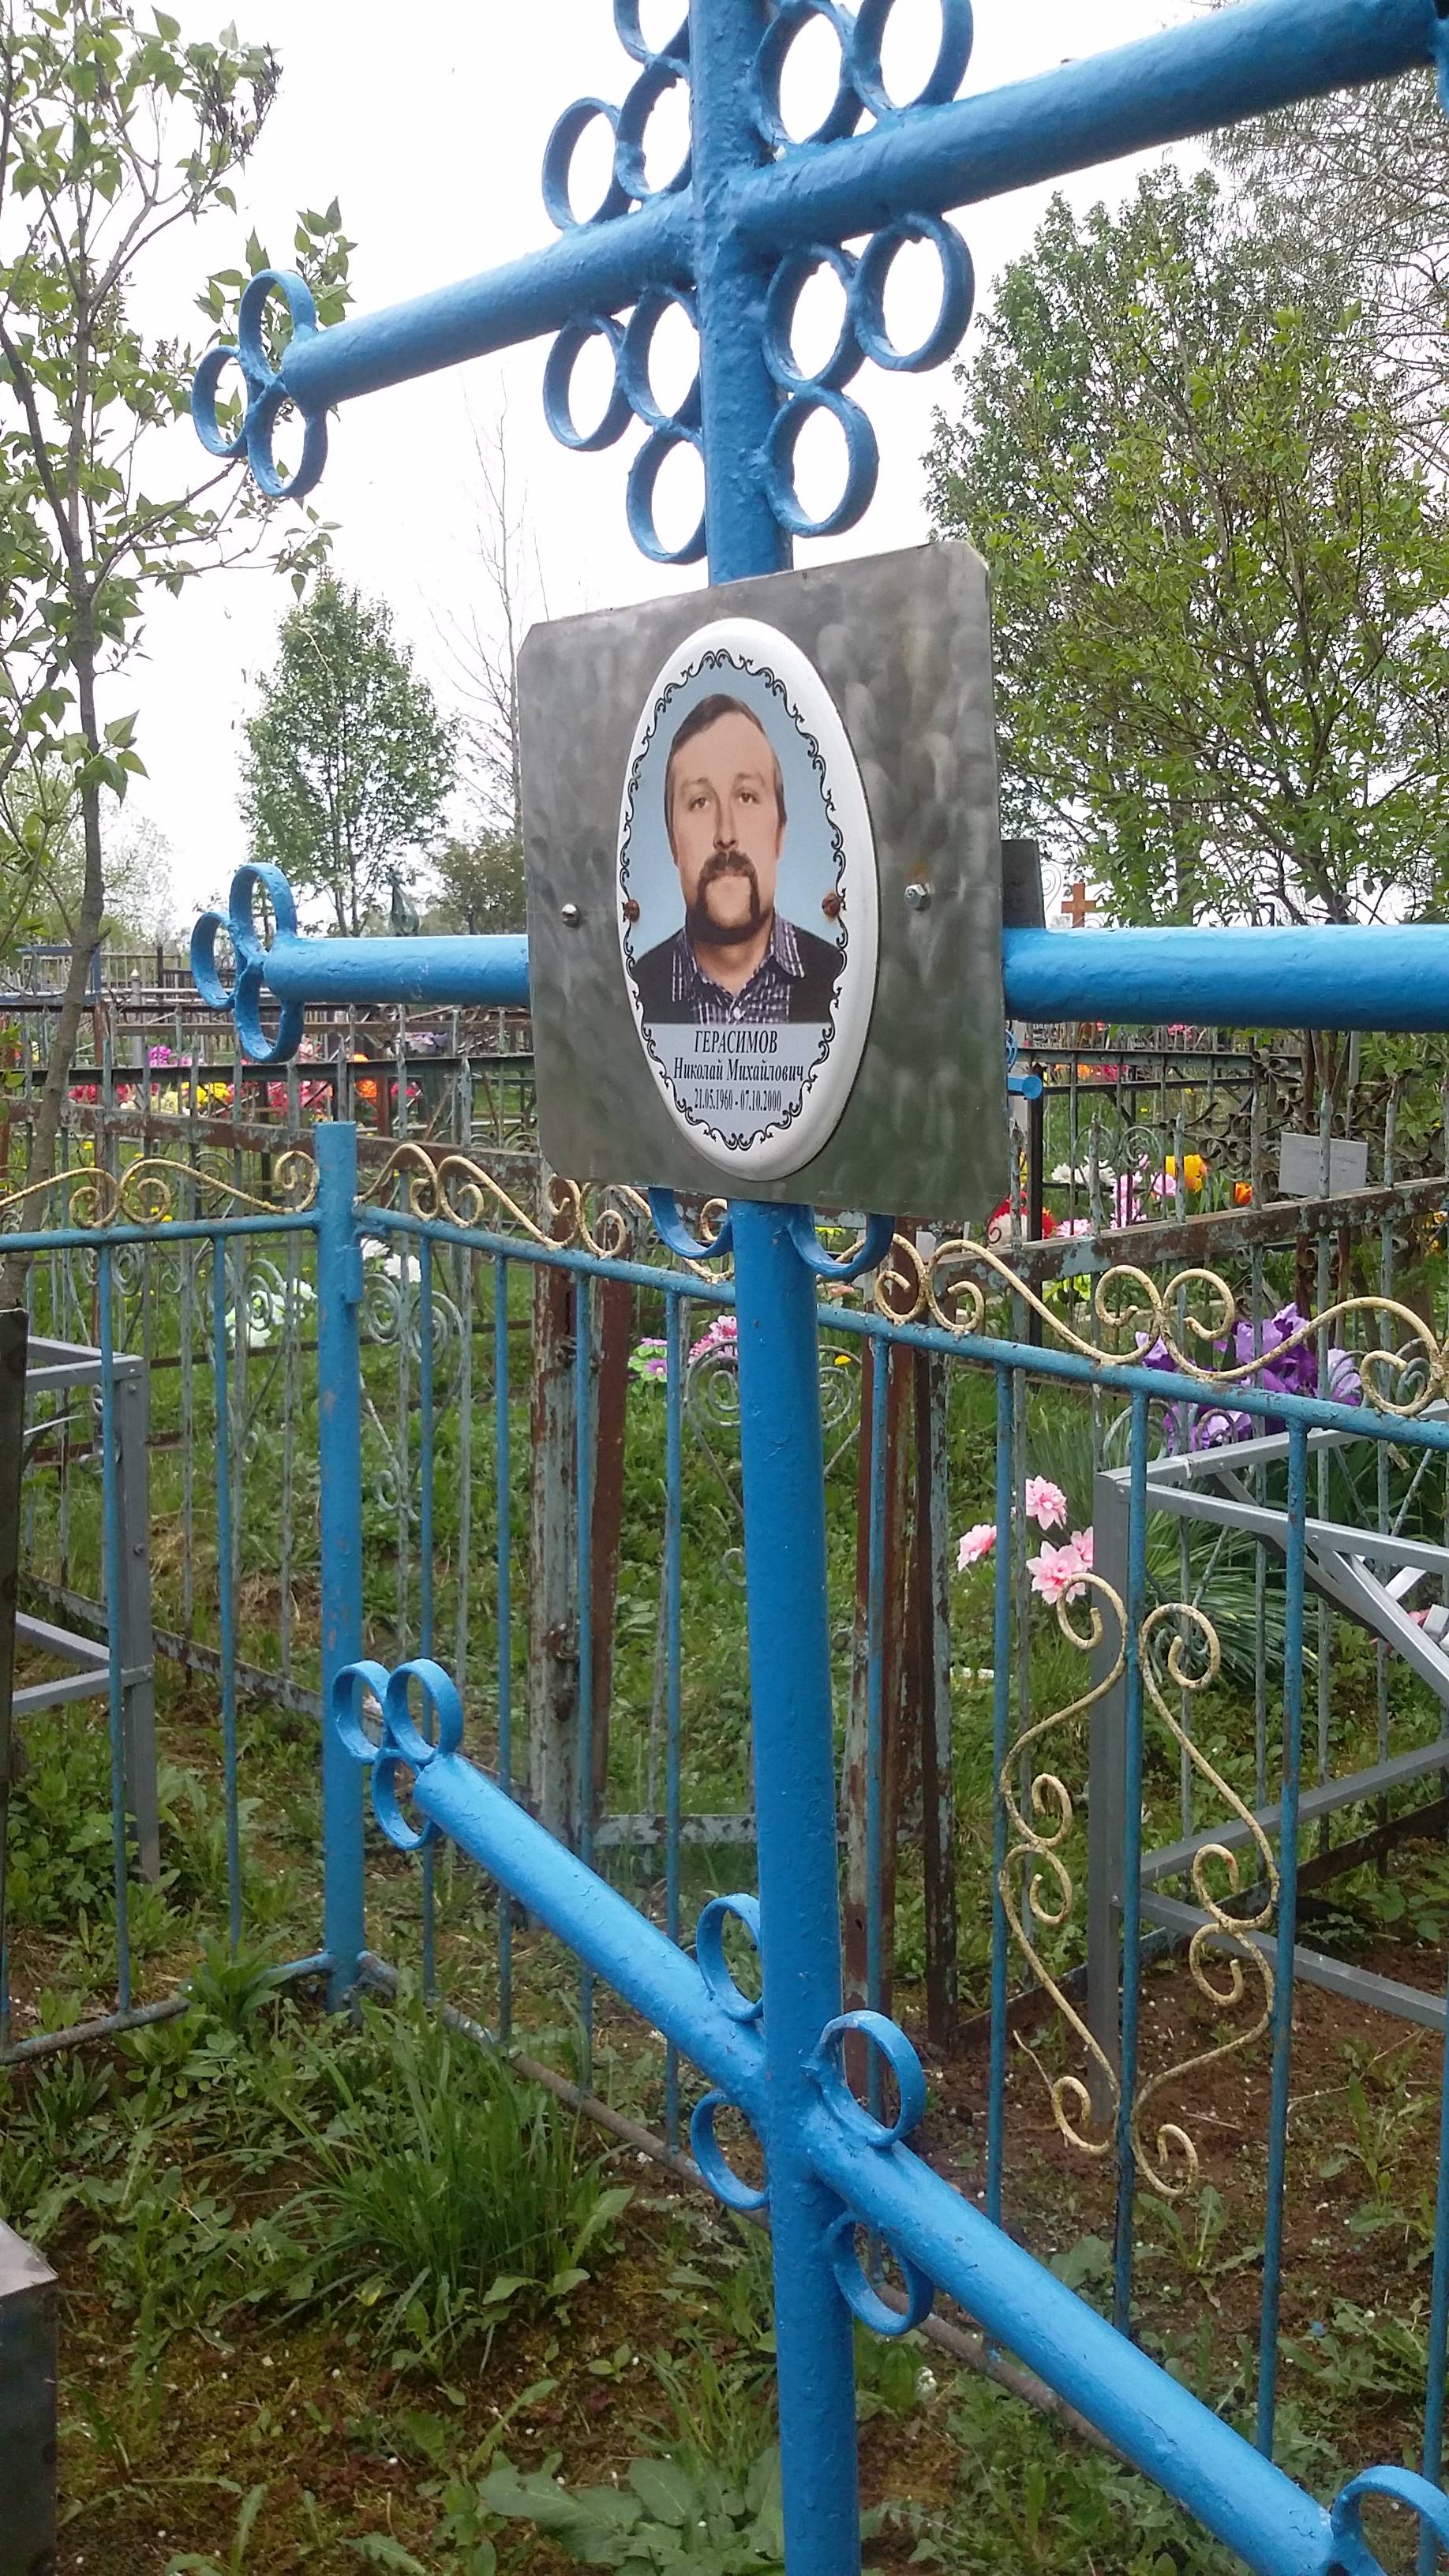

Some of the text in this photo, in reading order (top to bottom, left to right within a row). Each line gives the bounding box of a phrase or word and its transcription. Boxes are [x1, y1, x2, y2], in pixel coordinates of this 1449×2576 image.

[695, 1030, 777, 1054] ГЕРАСИМОВ
[673, 1058, 803, 1082] Николай Михайлович
[695, 1088, 732, 1110] 21.05.1960
[740, 1090, 781, 1112] 07.10.2000
